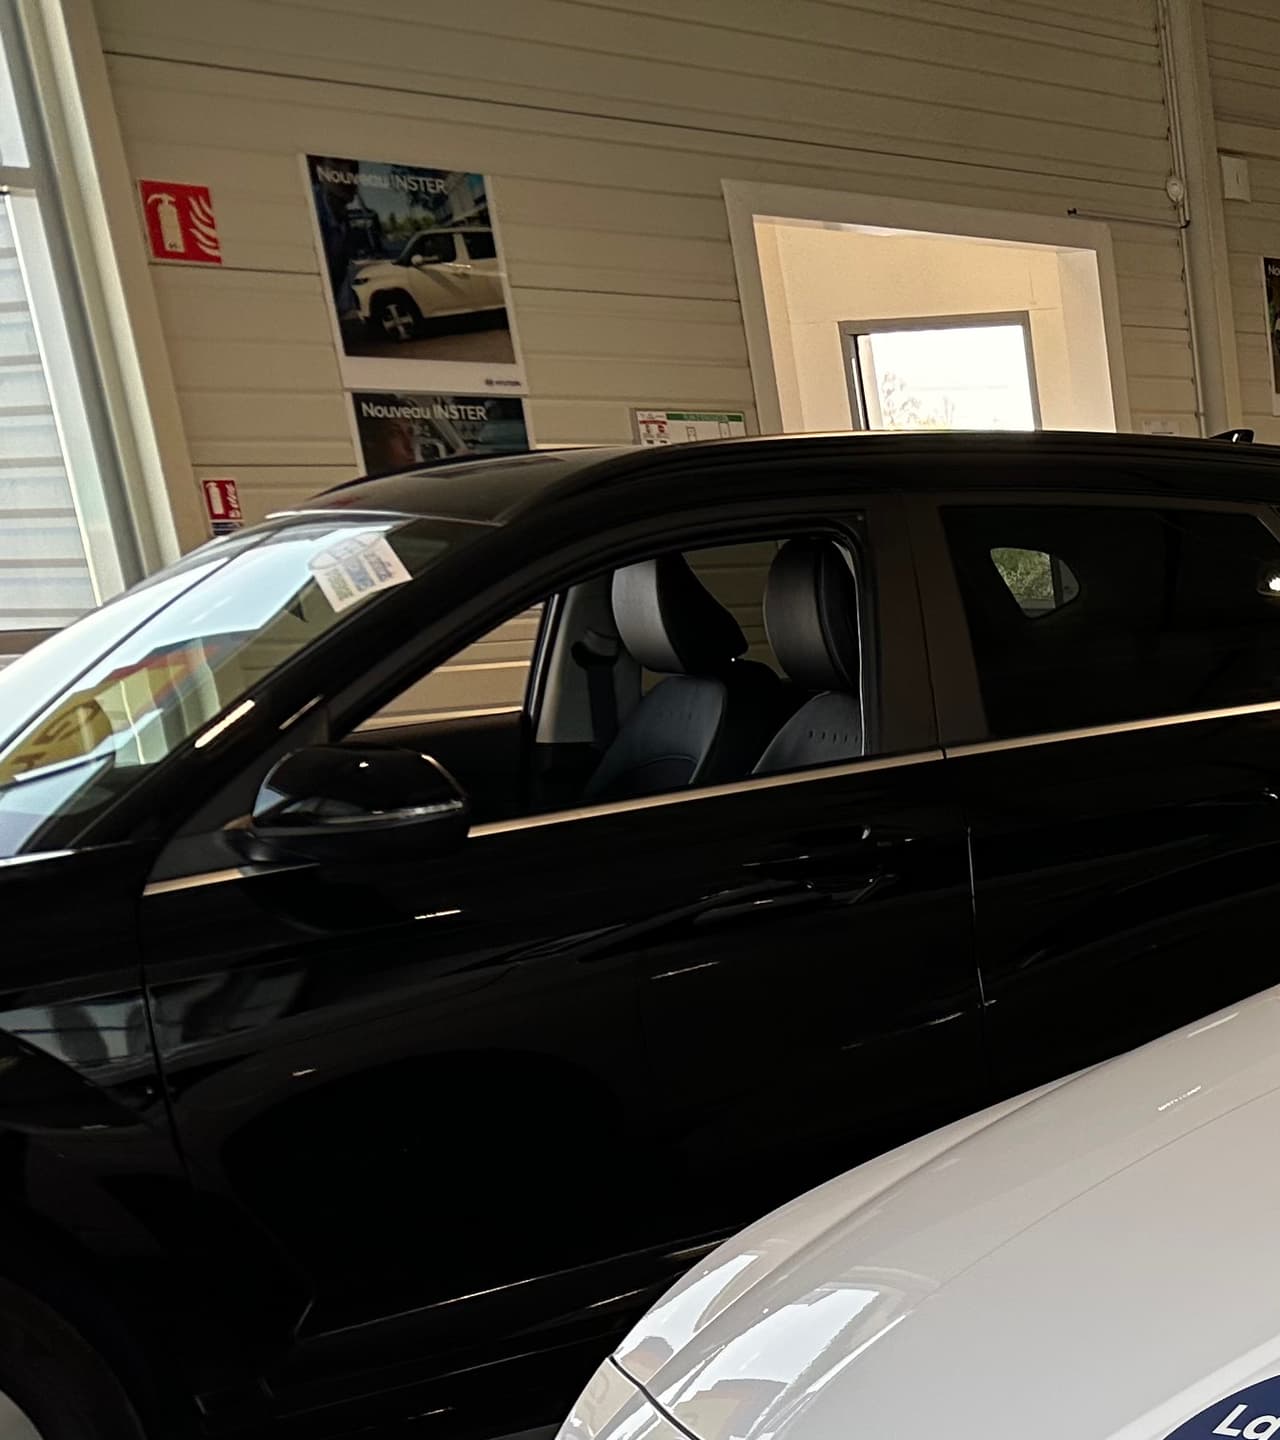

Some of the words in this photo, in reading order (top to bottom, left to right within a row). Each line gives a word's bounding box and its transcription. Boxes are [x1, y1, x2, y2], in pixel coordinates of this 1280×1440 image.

[317, 165, 388, 186] Nouveau
[390, 173, 447, 193] INSTER
[361, 402, 430, 419] Nouveau
[433, 404, 488, 421] INSTER
